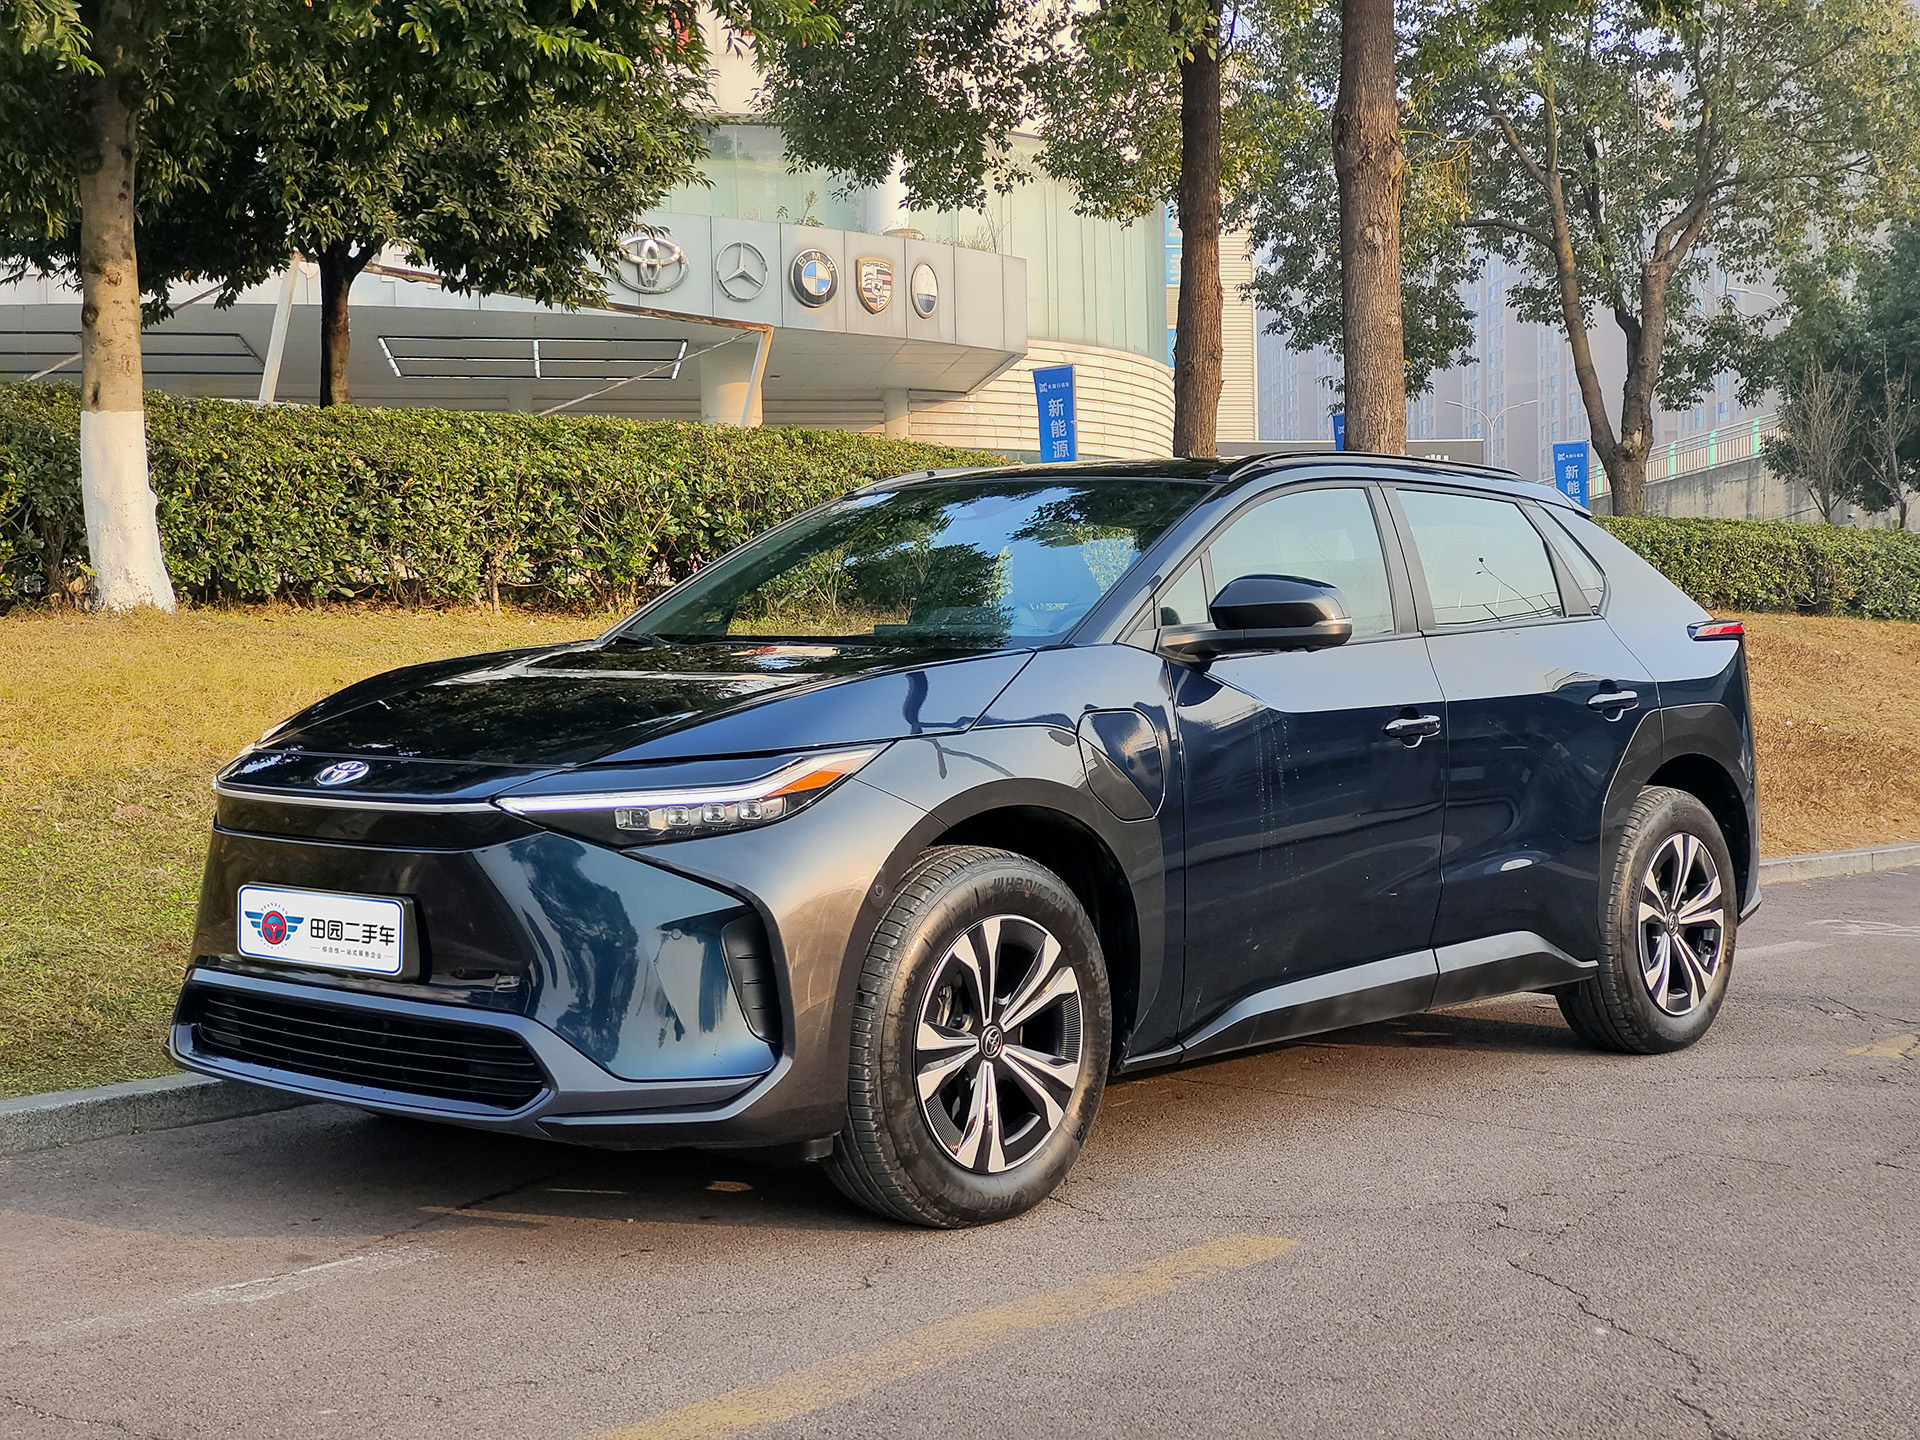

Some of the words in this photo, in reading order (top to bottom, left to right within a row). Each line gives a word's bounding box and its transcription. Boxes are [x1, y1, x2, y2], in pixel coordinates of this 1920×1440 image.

[797, 252, 835, 271] BMW
[862, 262, 892, 270] PORSCHE
[1048, 398, 1070, 459] 新能源
[311, 918, 395, 946] 田园二手车
